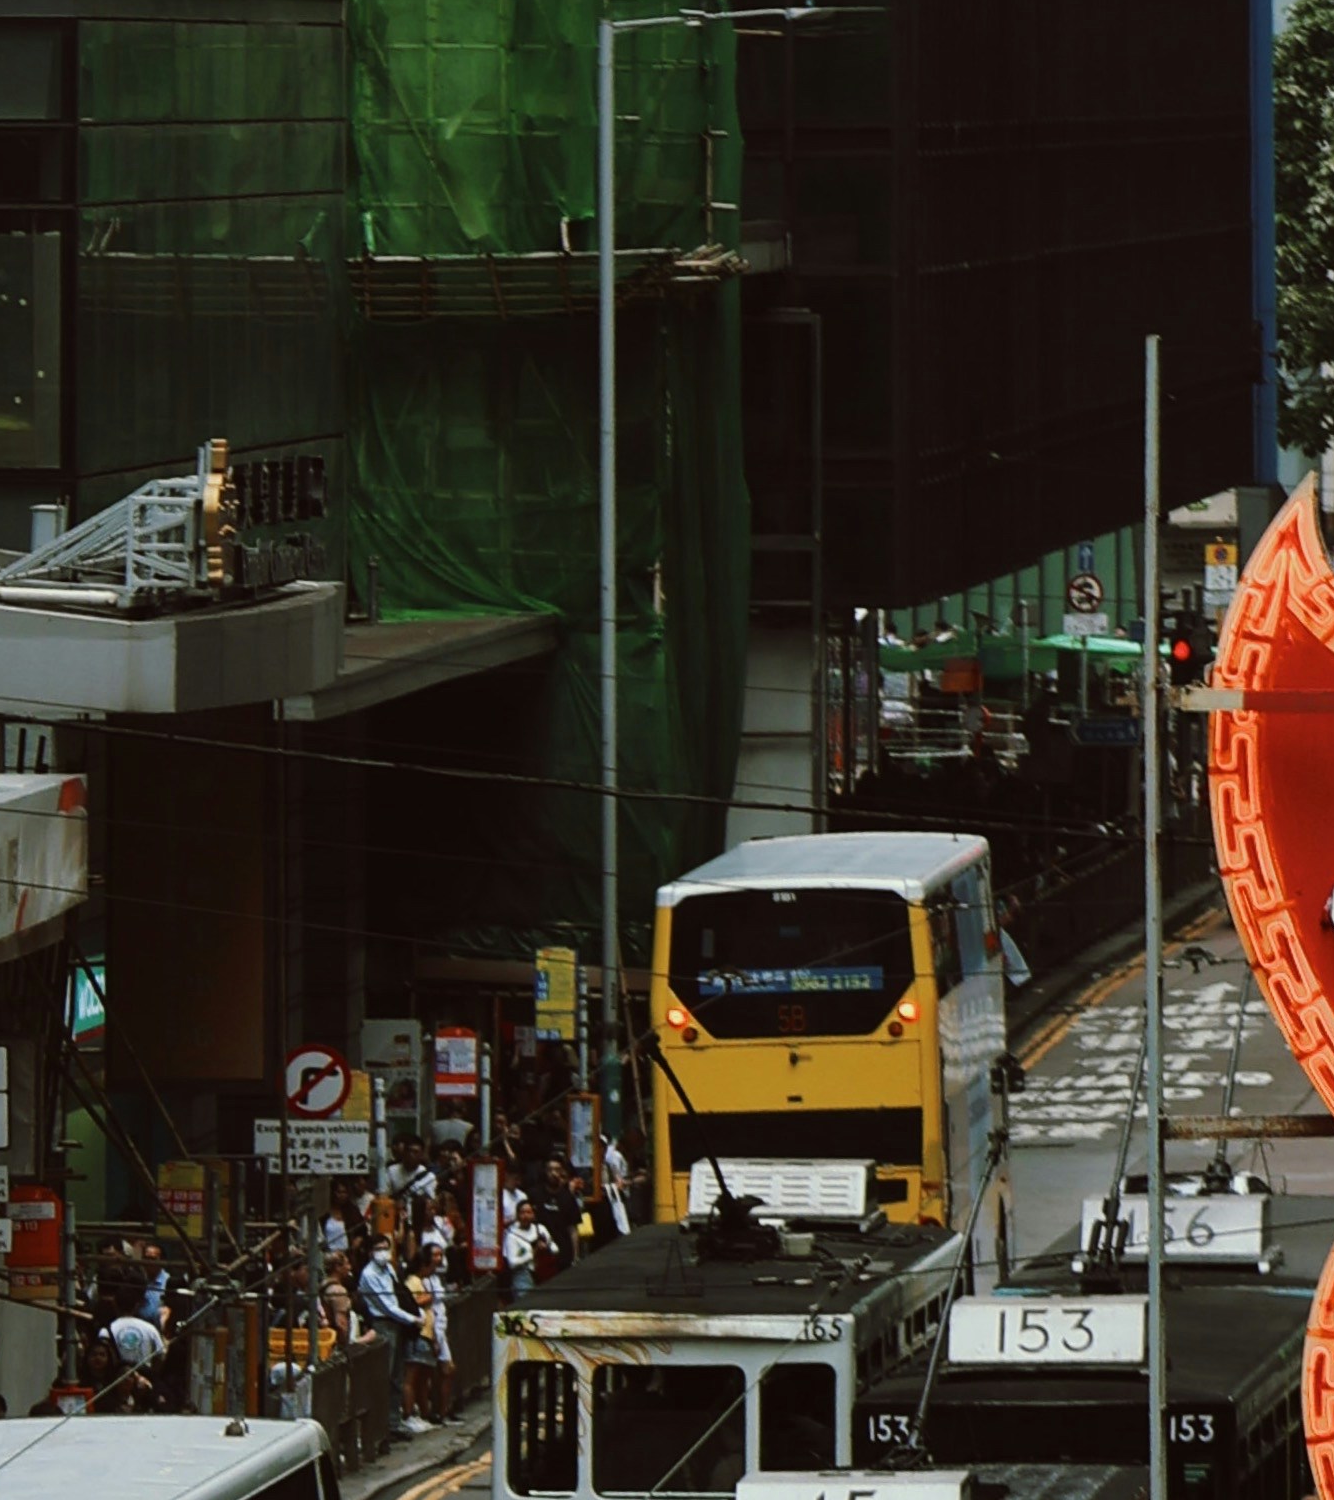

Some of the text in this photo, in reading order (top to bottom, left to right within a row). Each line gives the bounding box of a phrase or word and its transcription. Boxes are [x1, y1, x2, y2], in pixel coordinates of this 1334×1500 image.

[996, 1308, 1096, 1354] 153
[869, 1414, 1215, 1443] 153 153
